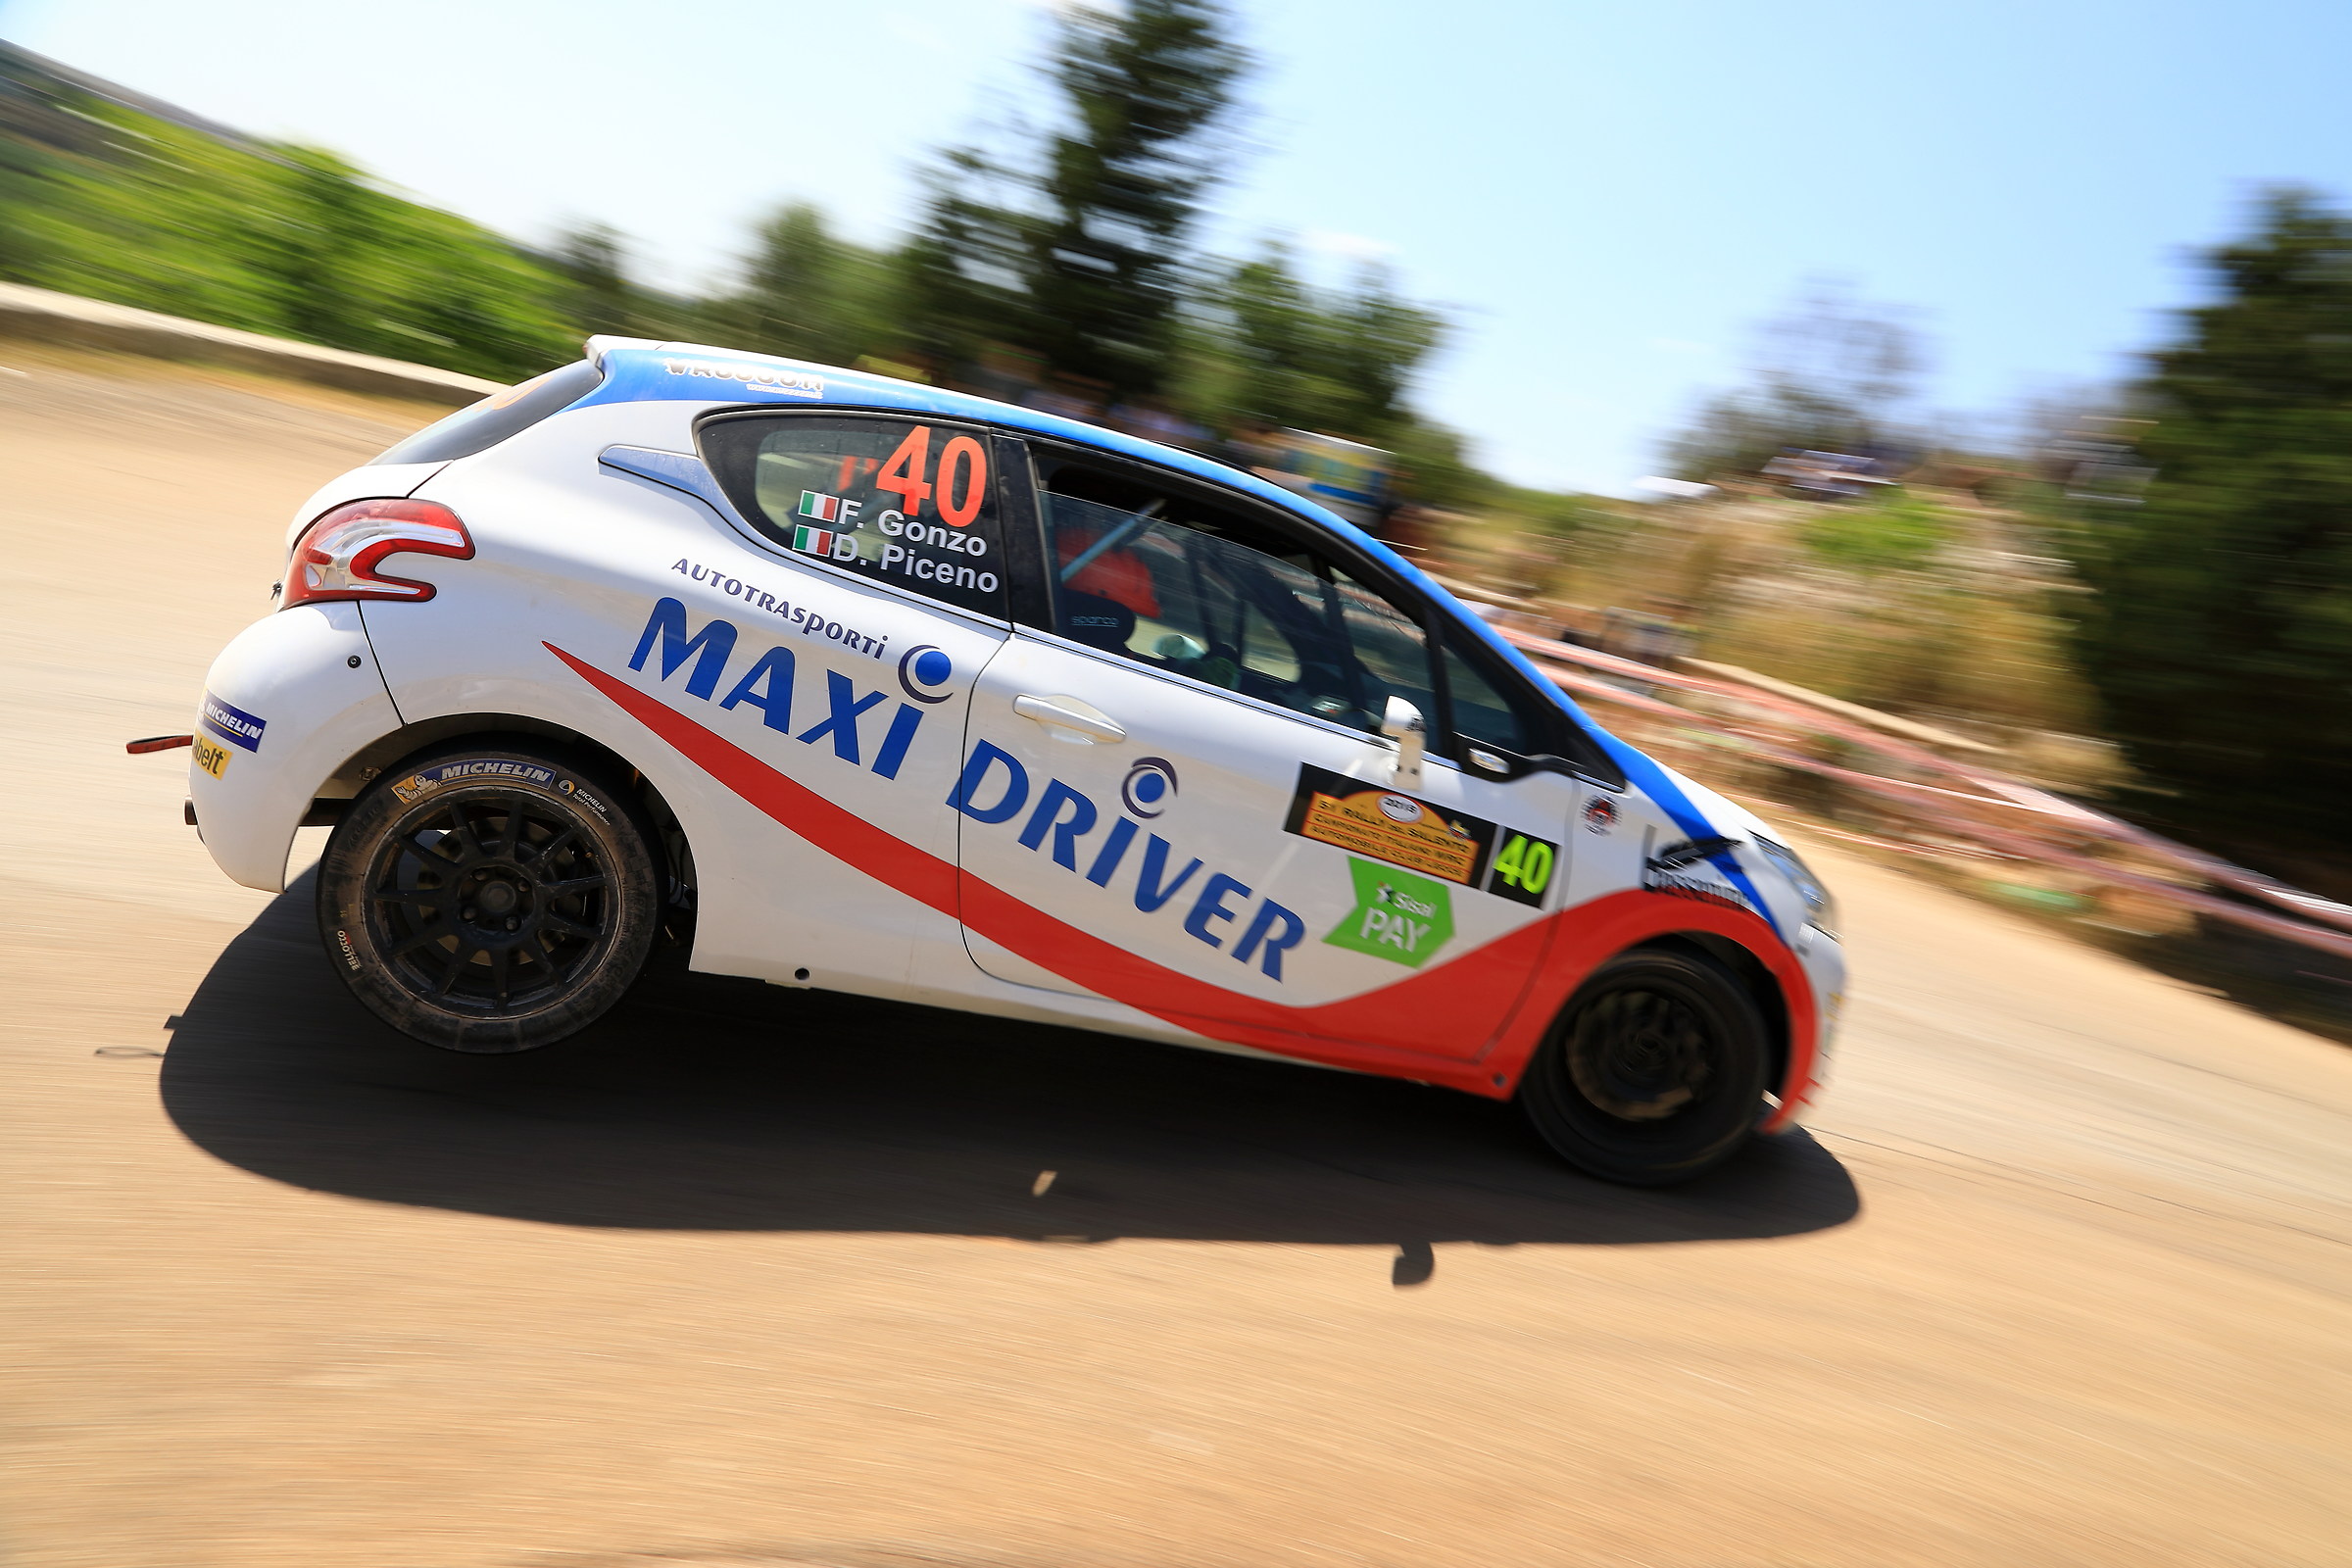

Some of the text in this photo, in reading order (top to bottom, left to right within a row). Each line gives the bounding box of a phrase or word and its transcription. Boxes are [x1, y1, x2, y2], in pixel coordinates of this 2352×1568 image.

[876, 425, 988, 527] 40
[839, 498, 988, 557] F. Gonzo
[833, 533, 999, 593] D. Piceno
[1071, 613, 1119, 627] sparco
[205, 702, 263, 740] MICHELIN
[441, 761, 552, 782] MICHELIN
[576, 788, 608, 812] MICHELIN
[1493, 834, 1554, 896] 40
[1359, 906, 1433, 954] PAY
